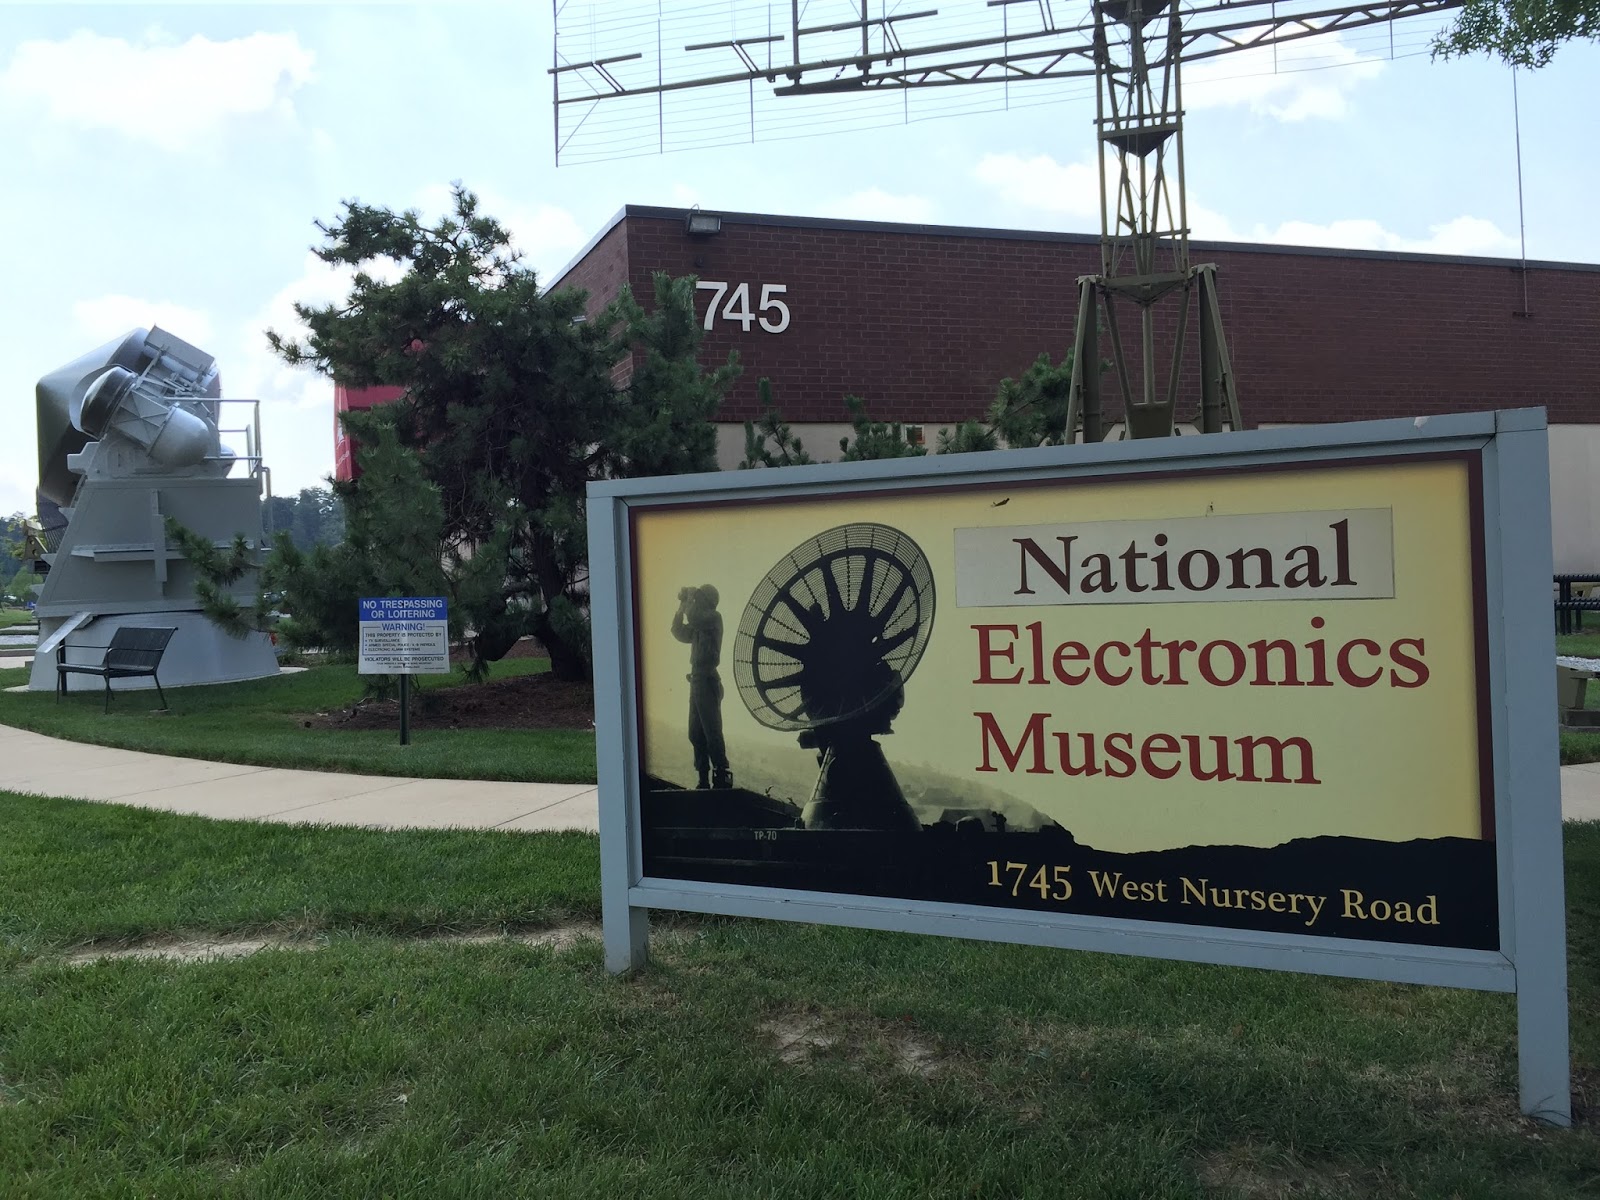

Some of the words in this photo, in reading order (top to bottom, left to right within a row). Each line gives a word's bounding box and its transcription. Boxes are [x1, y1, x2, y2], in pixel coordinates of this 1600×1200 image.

[690, 281, 790, 334] 745
[1012, 518, 1358, 595] National
[363, 600, 377, 609] NO
[380, 599, 443, 609] TRESPASSING
[371, 610, 385, 619] OR
[388, 609, 436, 618] LOITERING
[381, 622, 426, 631] WARNING!
[970, 616, 1430, 688] Electronics
[973, 712, 1322, 785] Museum
[753, 830, 777, 840] TP-70
[987, 861, 1072, 901] 1745
[1087, 870, 1168, 903] West
[1179, 877, 1327, 926] Nursery
[1339, 889, 1440, 925] Road
